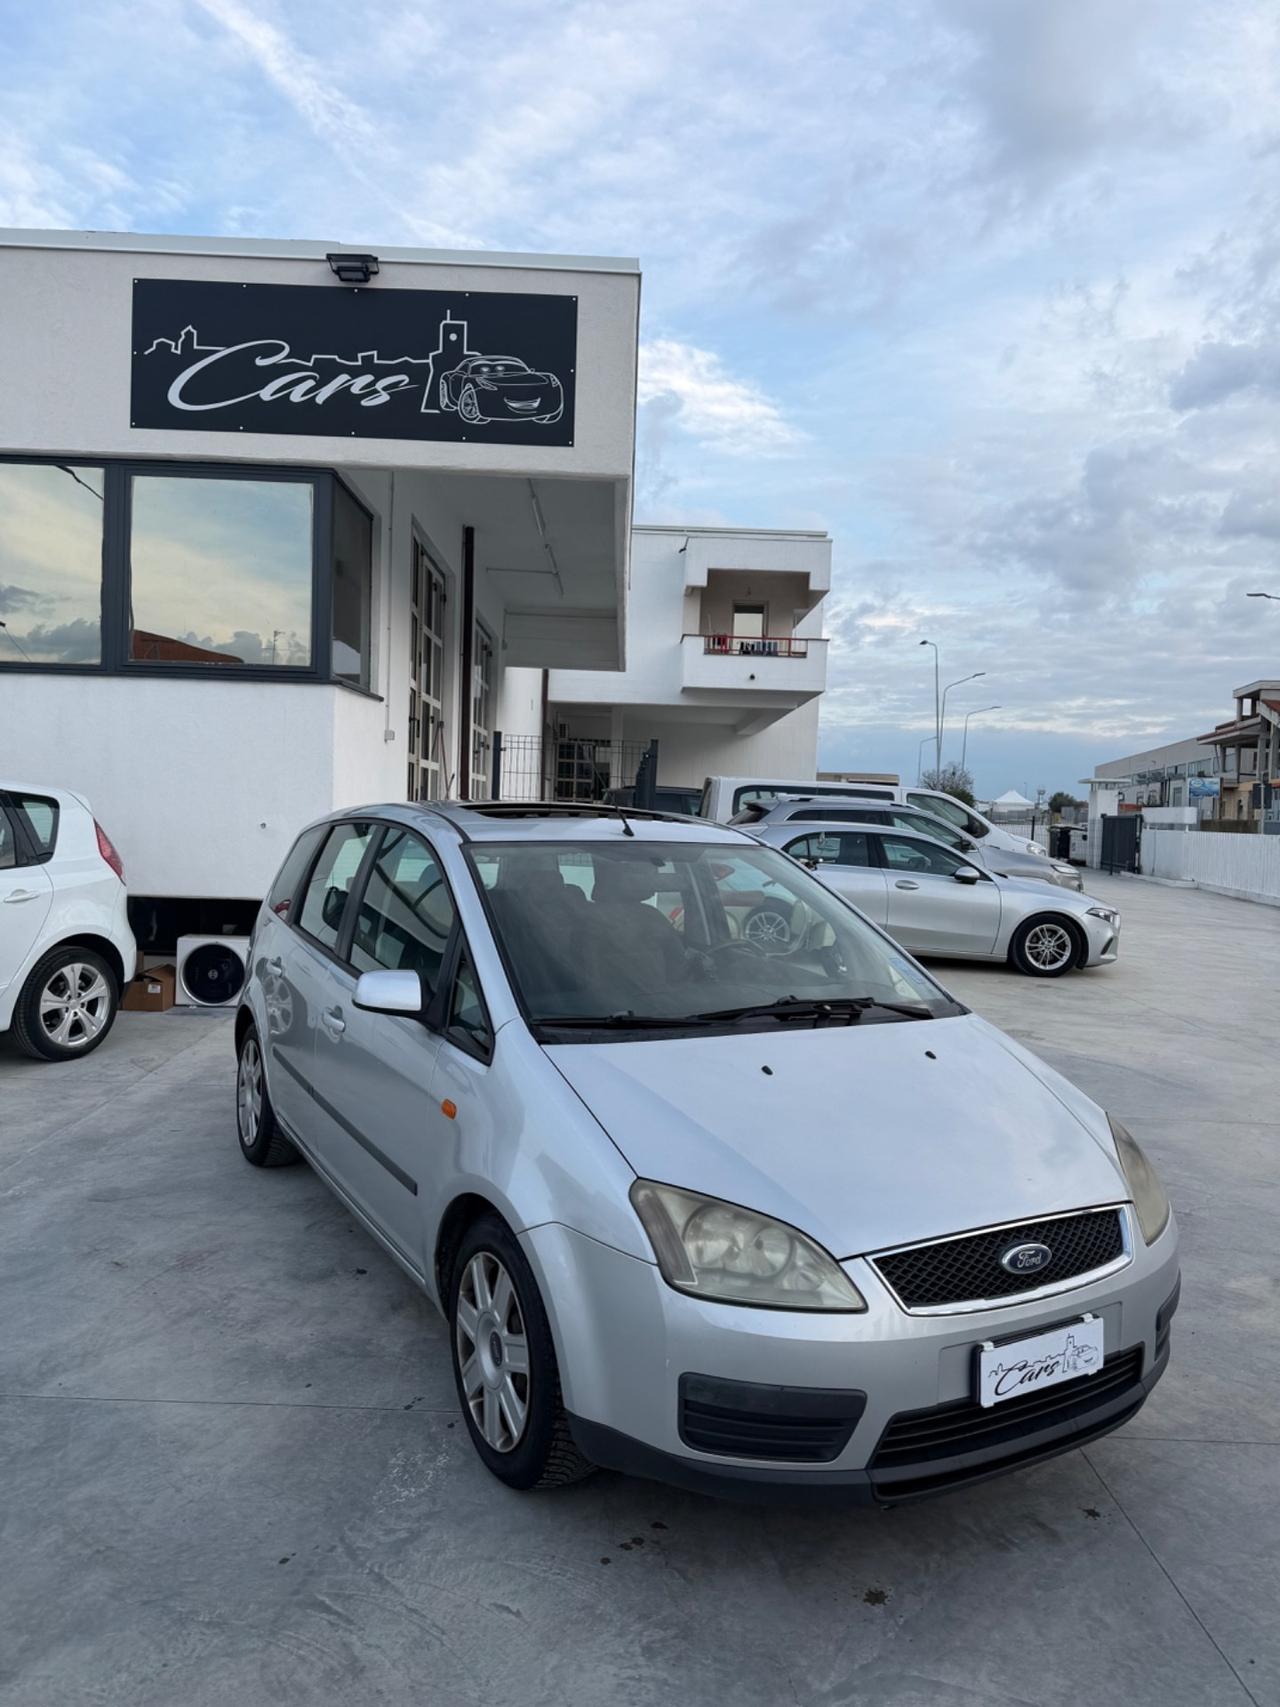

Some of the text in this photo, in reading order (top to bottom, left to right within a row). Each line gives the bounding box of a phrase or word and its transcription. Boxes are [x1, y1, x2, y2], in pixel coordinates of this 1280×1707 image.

[167, 339, 419, 411] Cars
[1017, 1250, 1042, 1268] Ford
[994, 1360, 1060, 1396] Cars
